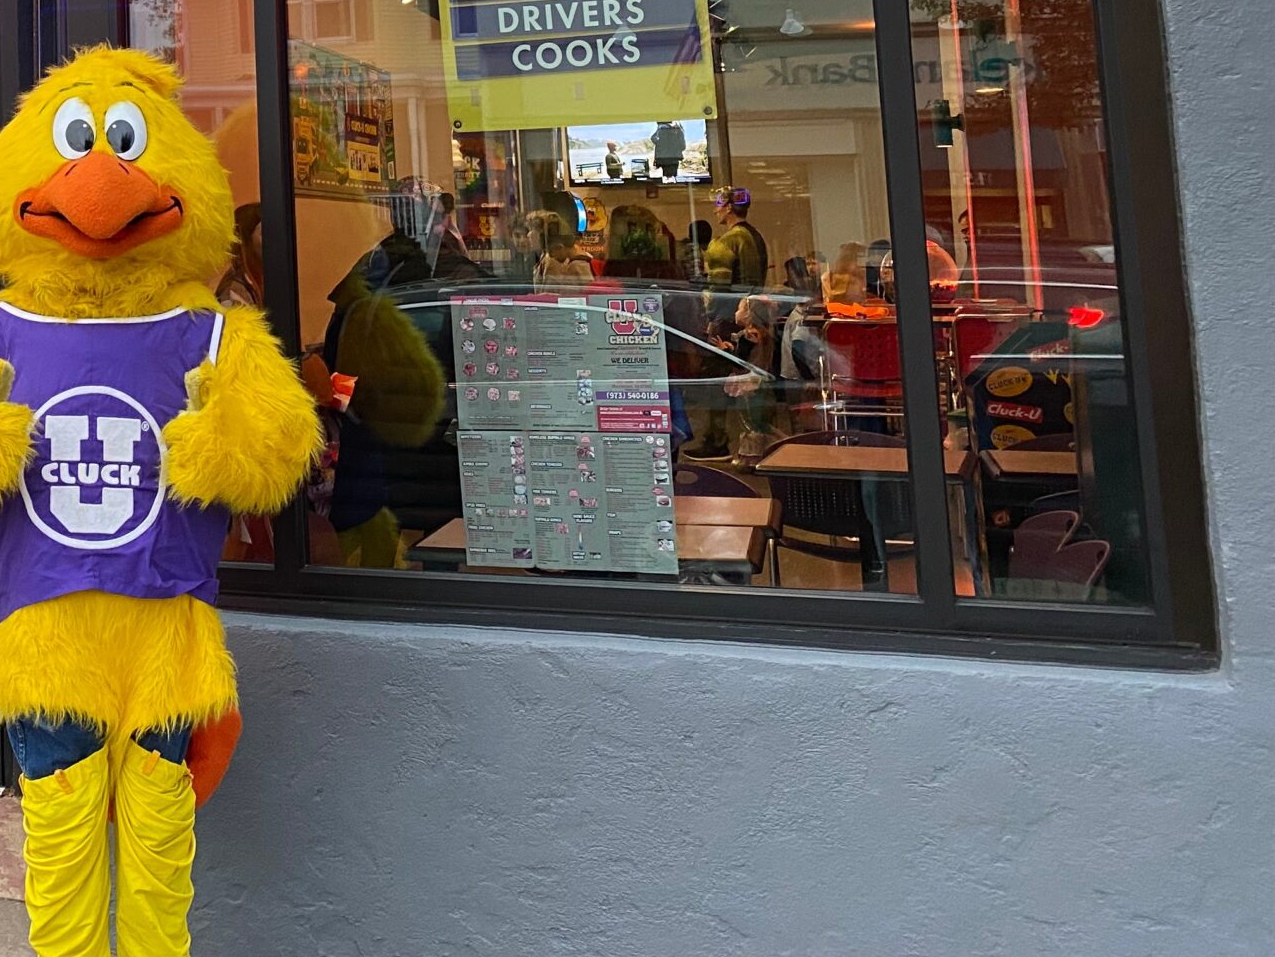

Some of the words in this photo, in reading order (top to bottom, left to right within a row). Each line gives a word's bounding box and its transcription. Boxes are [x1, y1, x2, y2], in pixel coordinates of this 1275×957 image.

[512, 34, 642, 72] COOKS
[609, 335, 659, 344] CHICKEN
[987, 404, 1043, 420] Cluck-U
[41, 461, 142, 487] CLUCK
